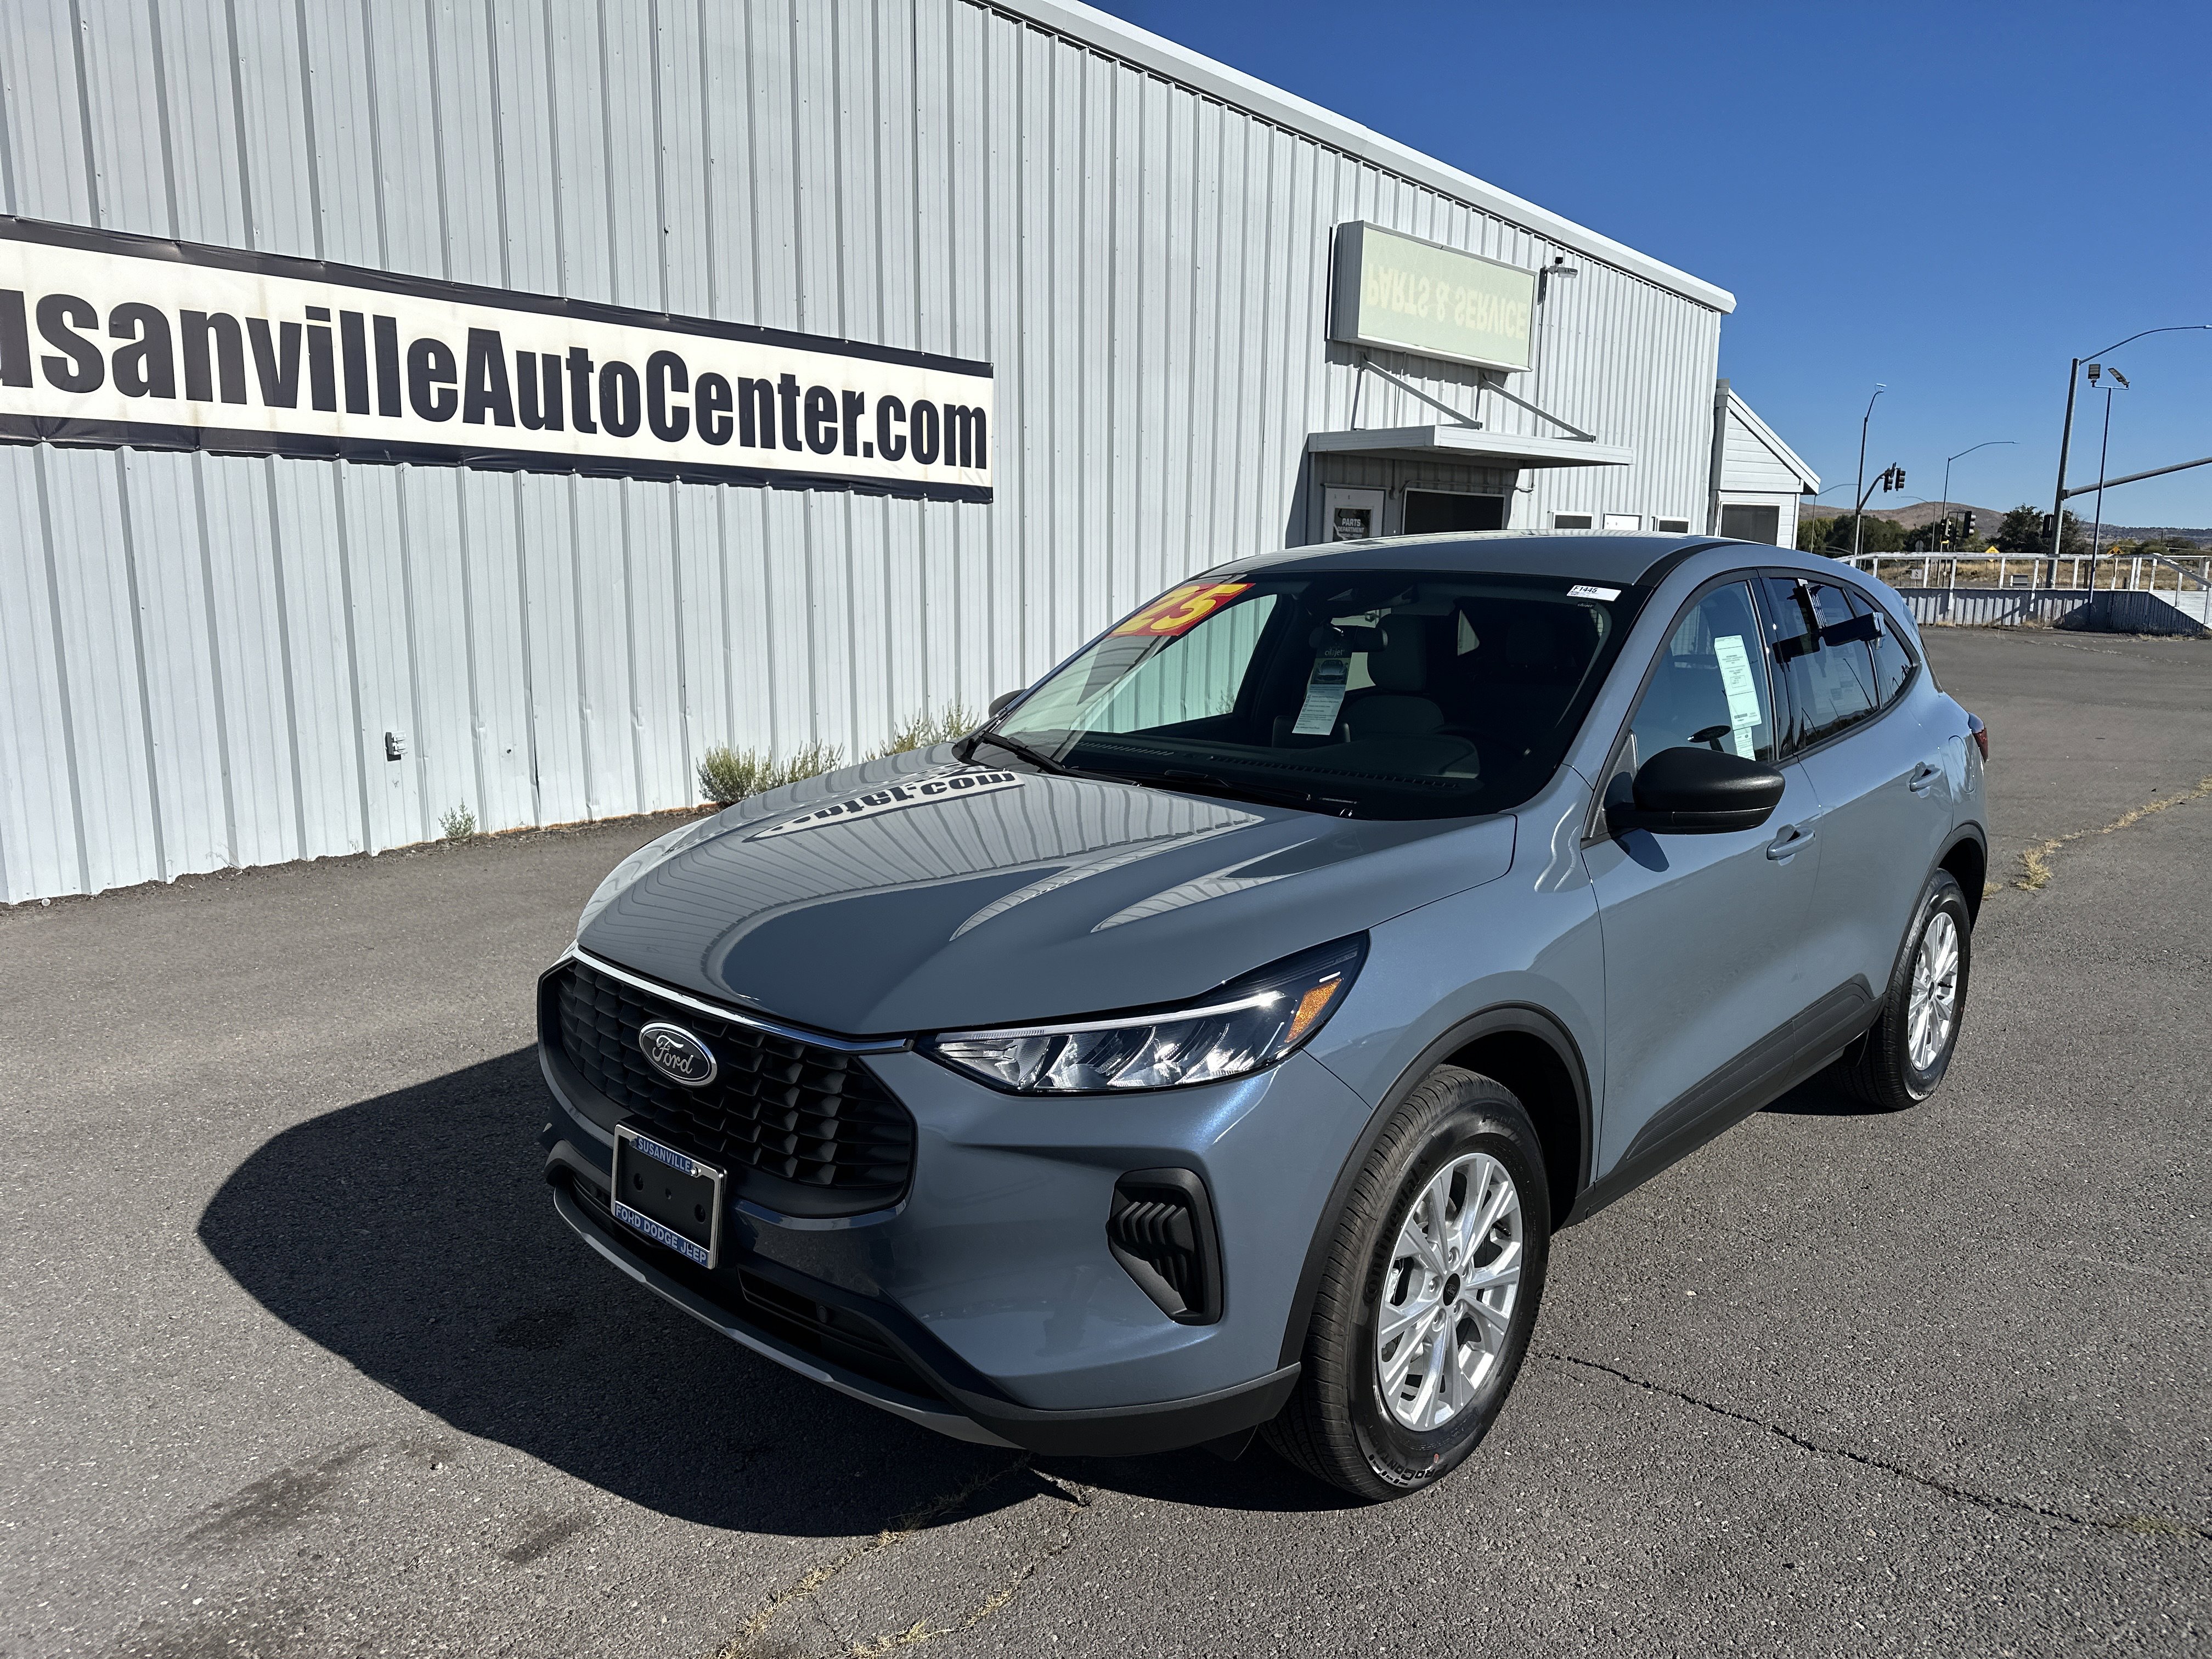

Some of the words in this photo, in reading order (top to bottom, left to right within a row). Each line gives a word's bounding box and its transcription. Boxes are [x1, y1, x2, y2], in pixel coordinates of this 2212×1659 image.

[1342, 518, 1361, 527] PARTS
[1113, 584, 1248, 634] 25
[652, 1035, 694, 1074] Ford
[637, 1138, 691, 1172] SUSANVILLE
[615, 1206, 641, 1228] FORD
[644, 1222, 678, 1249] DODGE
[680, 1241, 707, 1263] JEEP
